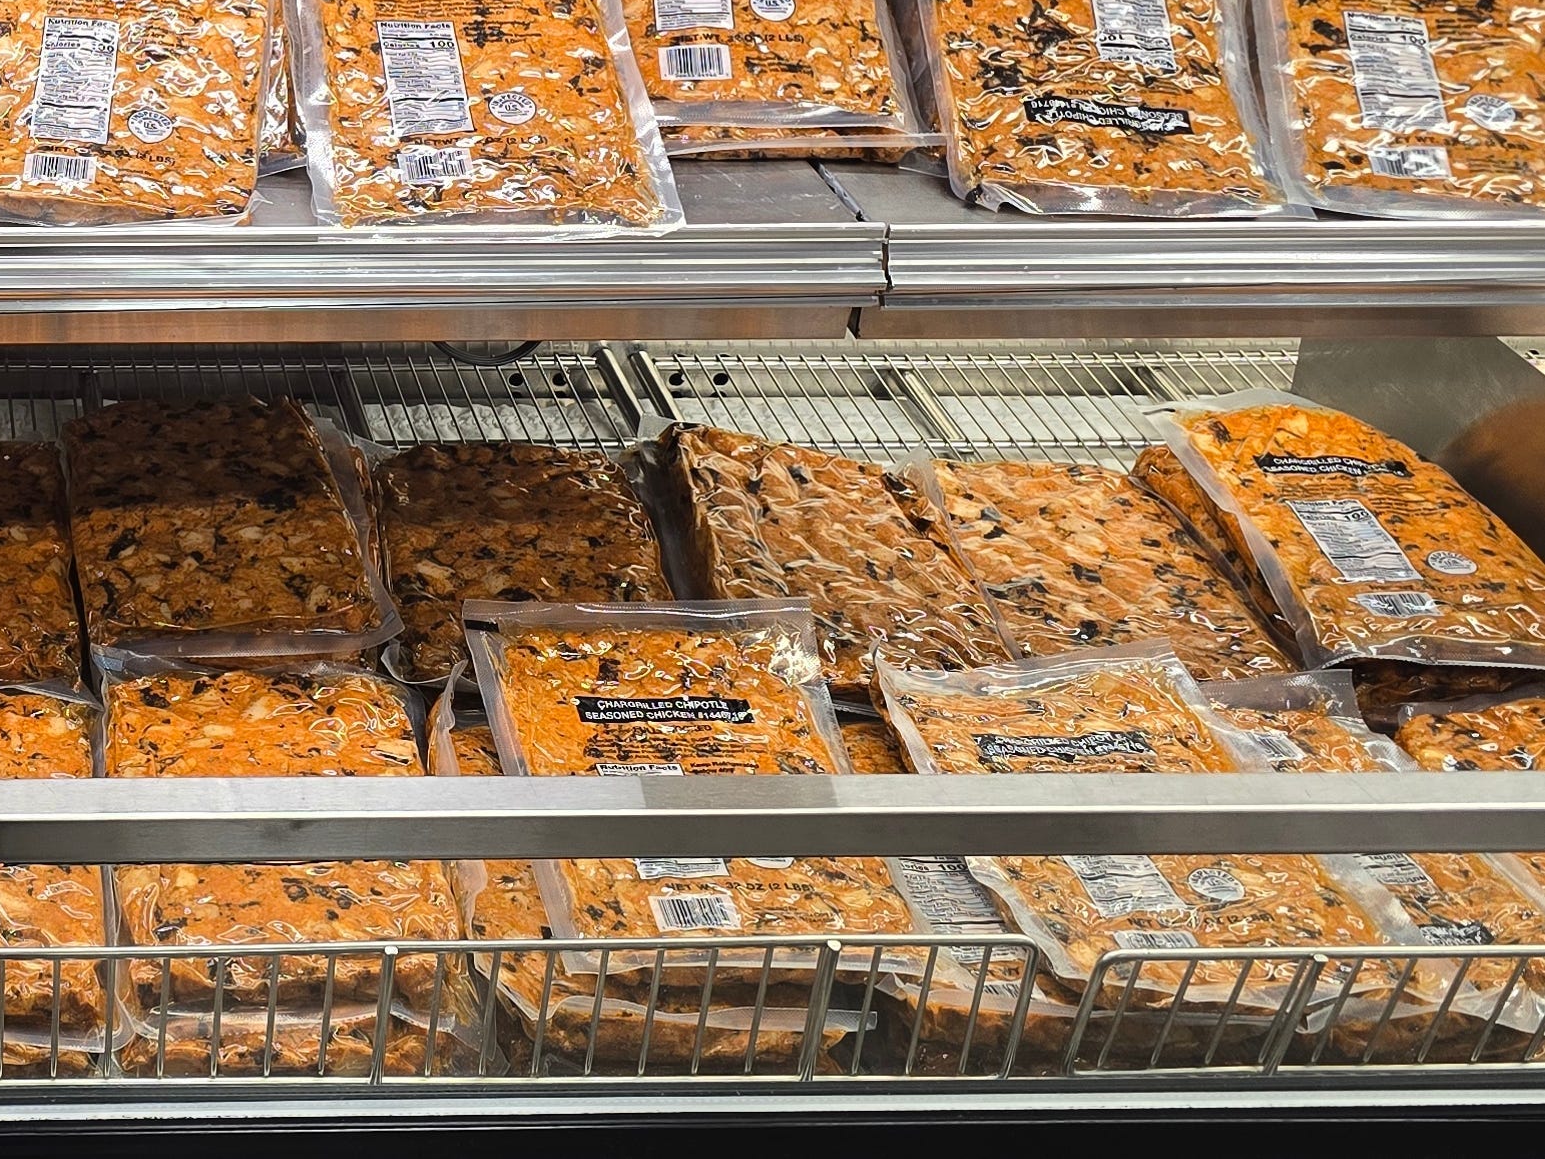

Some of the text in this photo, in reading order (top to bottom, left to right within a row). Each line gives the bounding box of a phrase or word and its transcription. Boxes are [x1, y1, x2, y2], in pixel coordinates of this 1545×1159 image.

[675, 700, 729, 710] CHIPOTLE
[585, 711, 695, 720] SEASONED CHICKEN
[937, 862, 966, 871] 100
